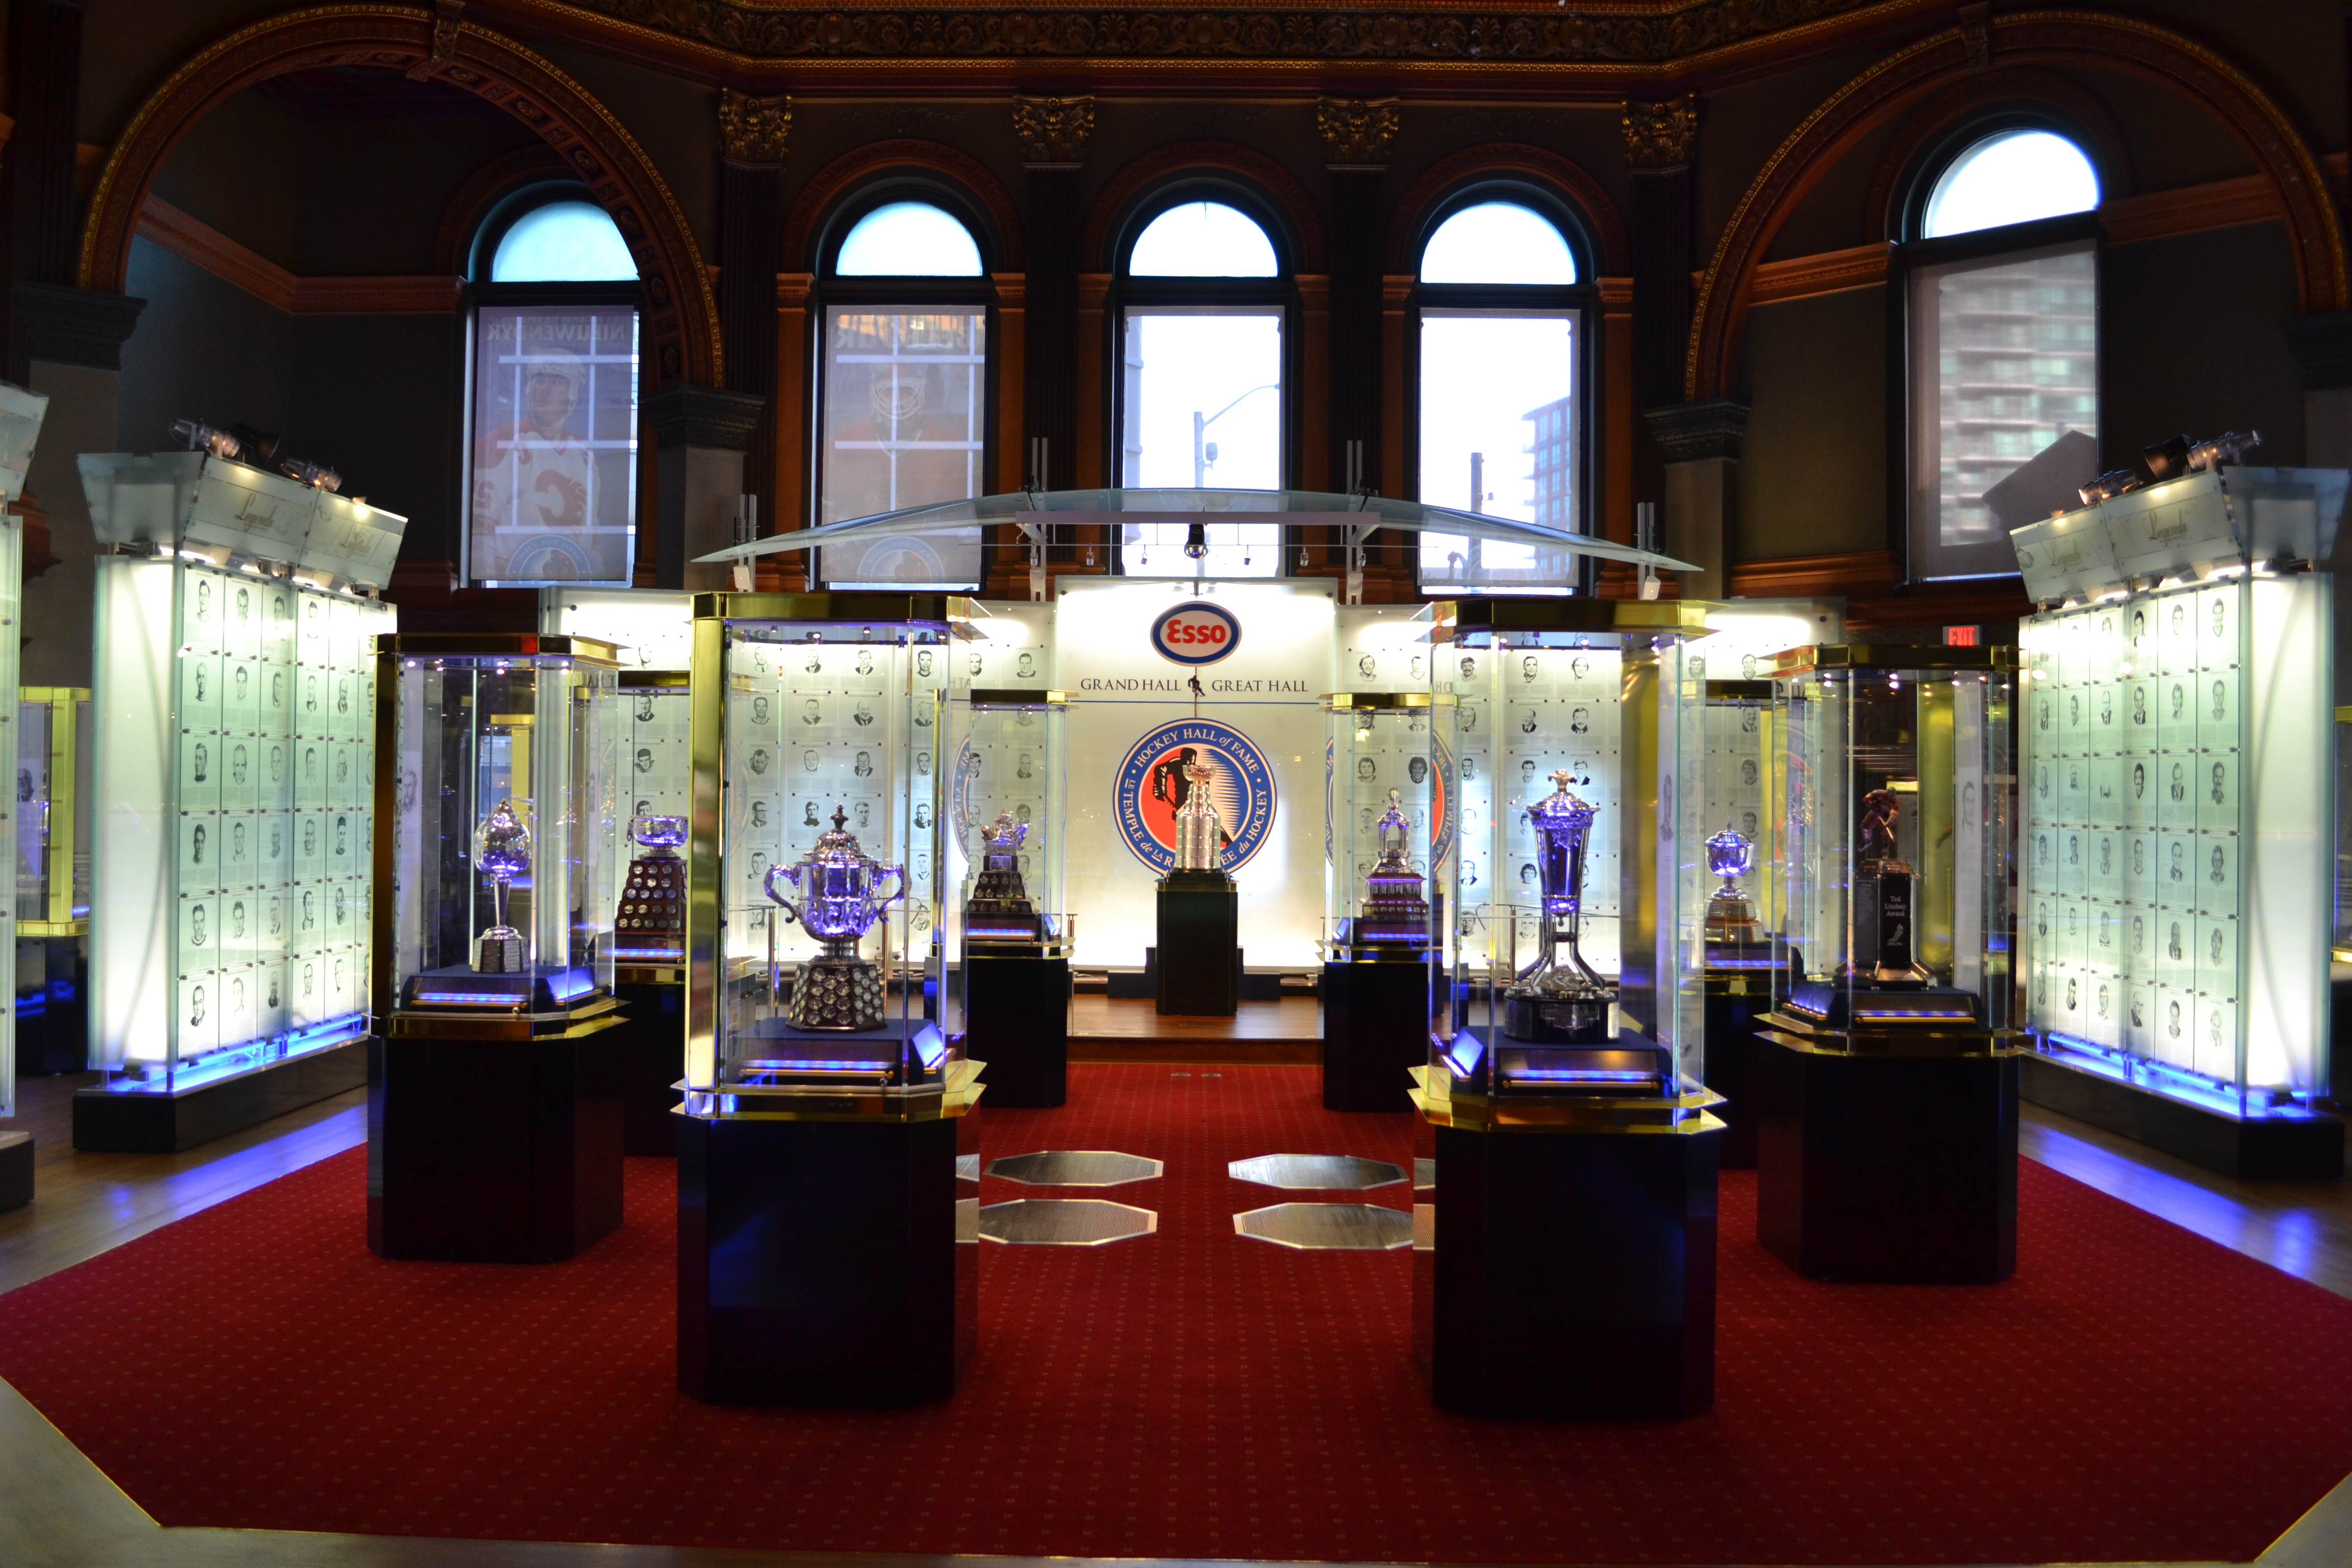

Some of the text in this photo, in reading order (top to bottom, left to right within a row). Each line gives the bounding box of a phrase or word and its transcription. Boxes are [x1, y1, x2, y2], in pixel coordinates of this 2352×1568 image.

[1948, 627, 1974, 646] EXIT
[1081, 678, 1182, 691] GRAND HALL
[1212, 679, 1309, 692] GREAT HALL
[1134, 728, 1260, 774] HOCKEY HALL of FAME
[1123, 792, 1144, 841] TEMPLE
[1140, 842, 1153, 853] de
[1239, 789, 1267, 854] du HOCKEY
